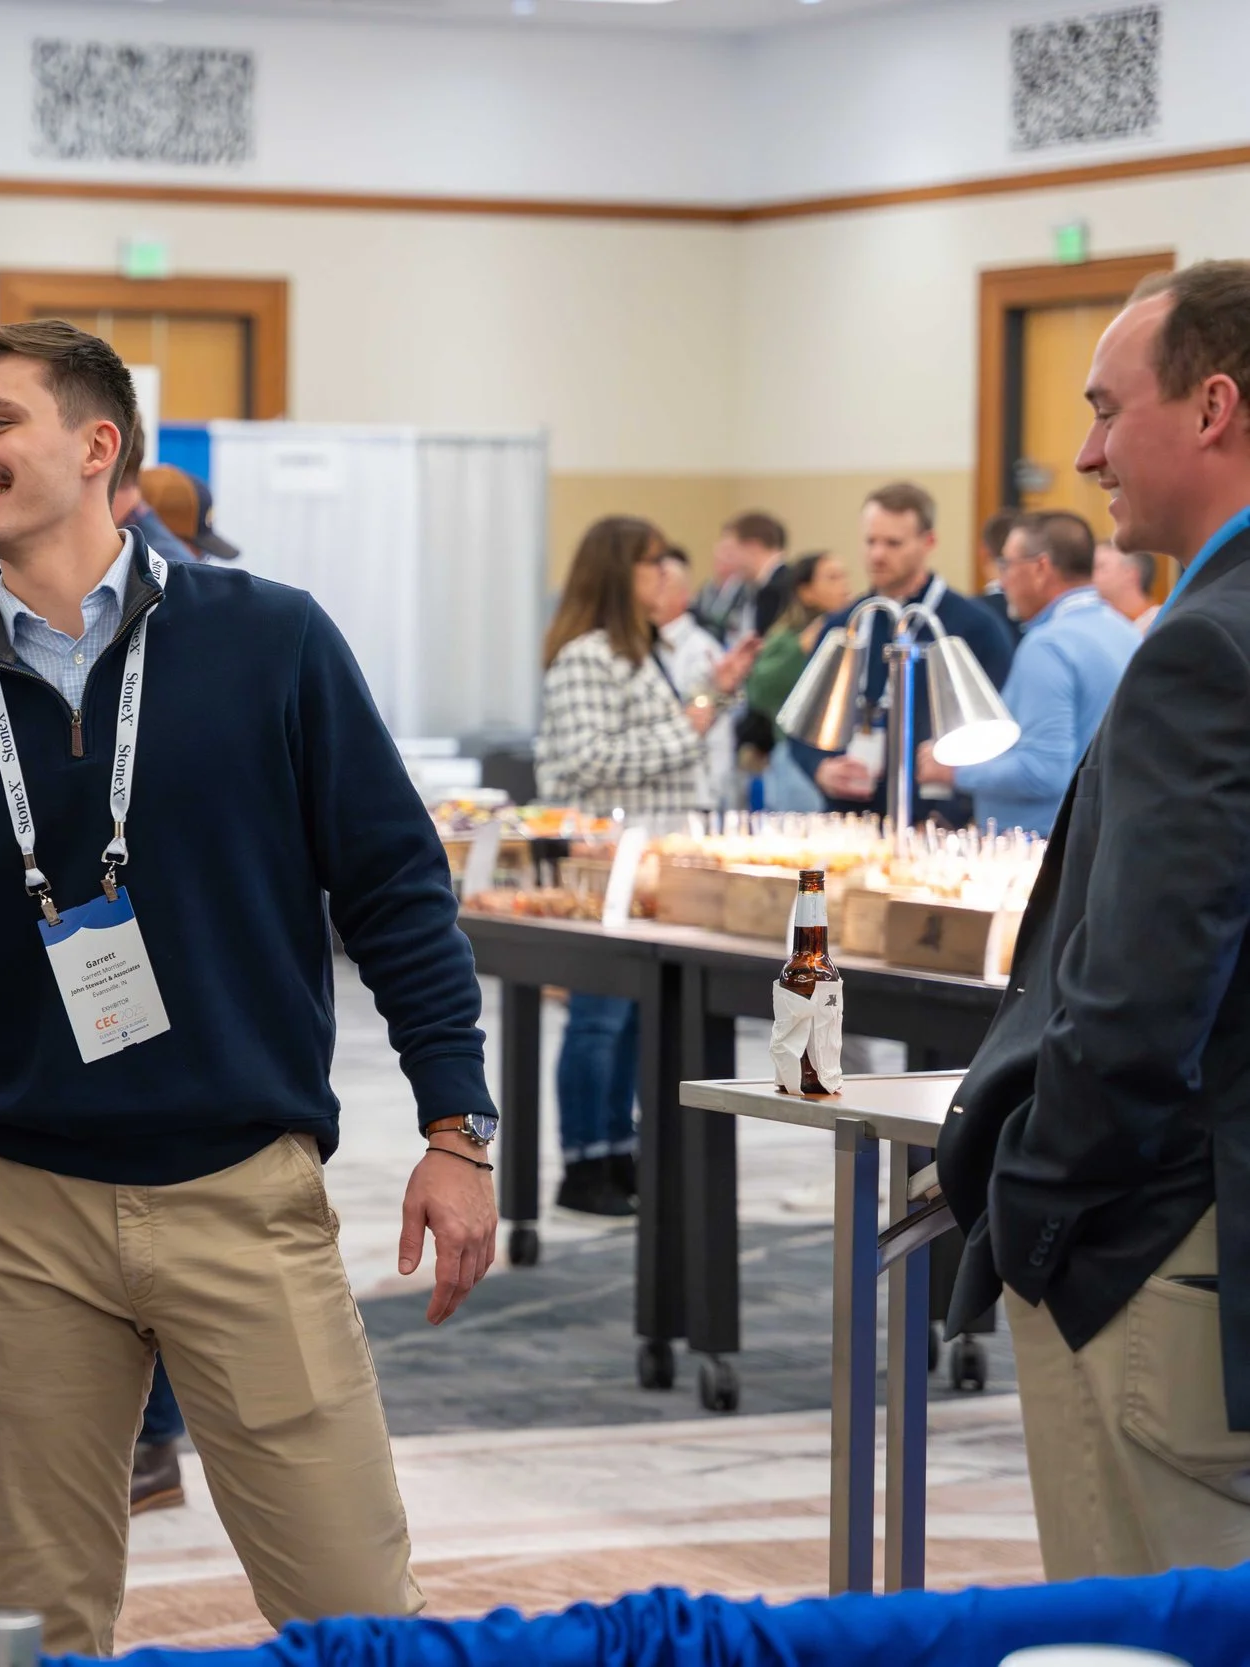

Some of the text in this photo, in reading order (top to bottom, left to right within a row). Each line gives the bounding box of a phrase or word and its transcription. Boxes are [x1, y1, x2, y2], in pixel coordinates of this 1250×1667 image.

[151, 558, 164, 581] Ston
[121, 673, 139, 726] StoneX
[113, 744, 131, 800] StoneX
[9, 781, 31, 834] StoneX
[81, 960, 127, 982] Garrett Morrison
[85, 952, 117, 969] Garrett
[70, 987, 85, 996] John
[85, 978, 108, 990] Stewart
[113, 964, 141, 979] Associates
[101, 997, 129, 1013] EXHIBITOR
[95, 1013, 119, 1030] CEC
